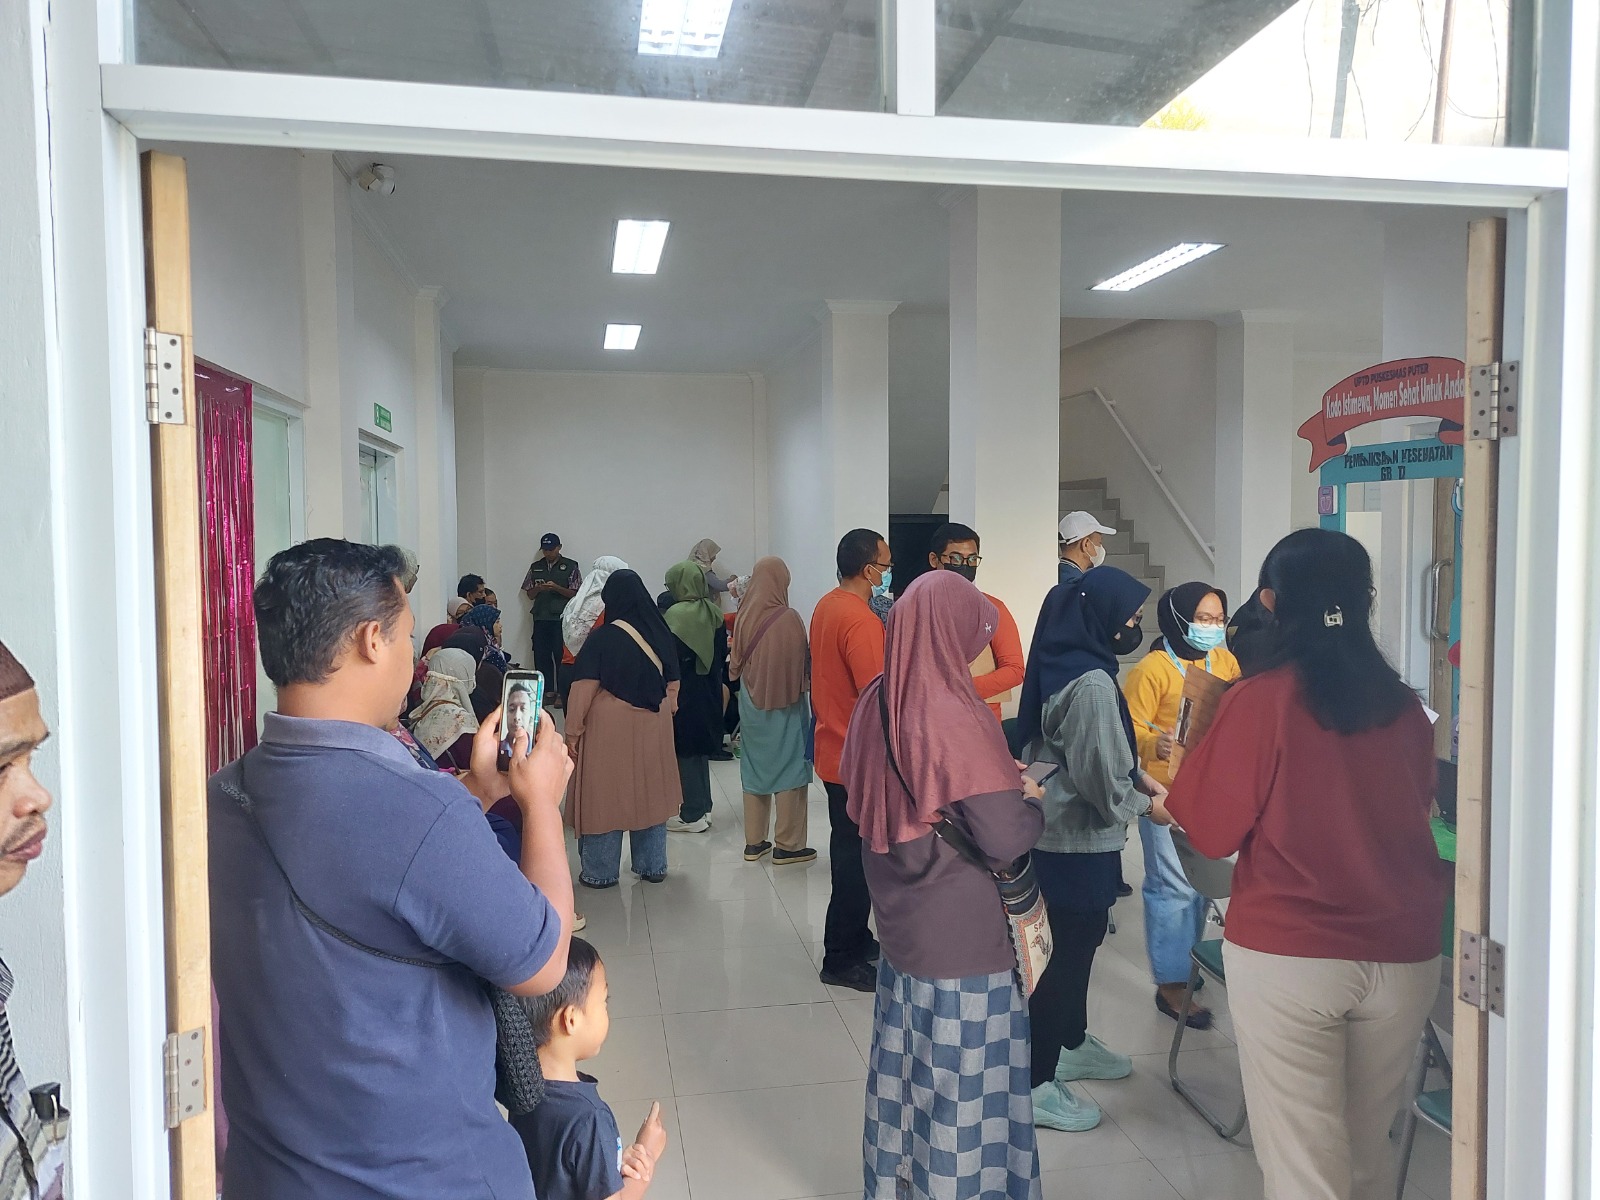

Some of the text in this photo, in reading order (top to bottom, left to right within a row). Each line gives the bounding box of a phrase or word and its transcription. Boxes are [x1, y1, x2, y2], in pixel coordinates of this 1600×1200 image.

[1408, 363, 1429, 377] PUTER
[1326, 393, 1342, 419] Kado
[1343, 390, 1372, 416] Istimewa,
[1373, 386, 1398, 411] Momen
[1399, 379, 1420, 407] Sehat
[1421, 373, 1443, 404] Untuk
